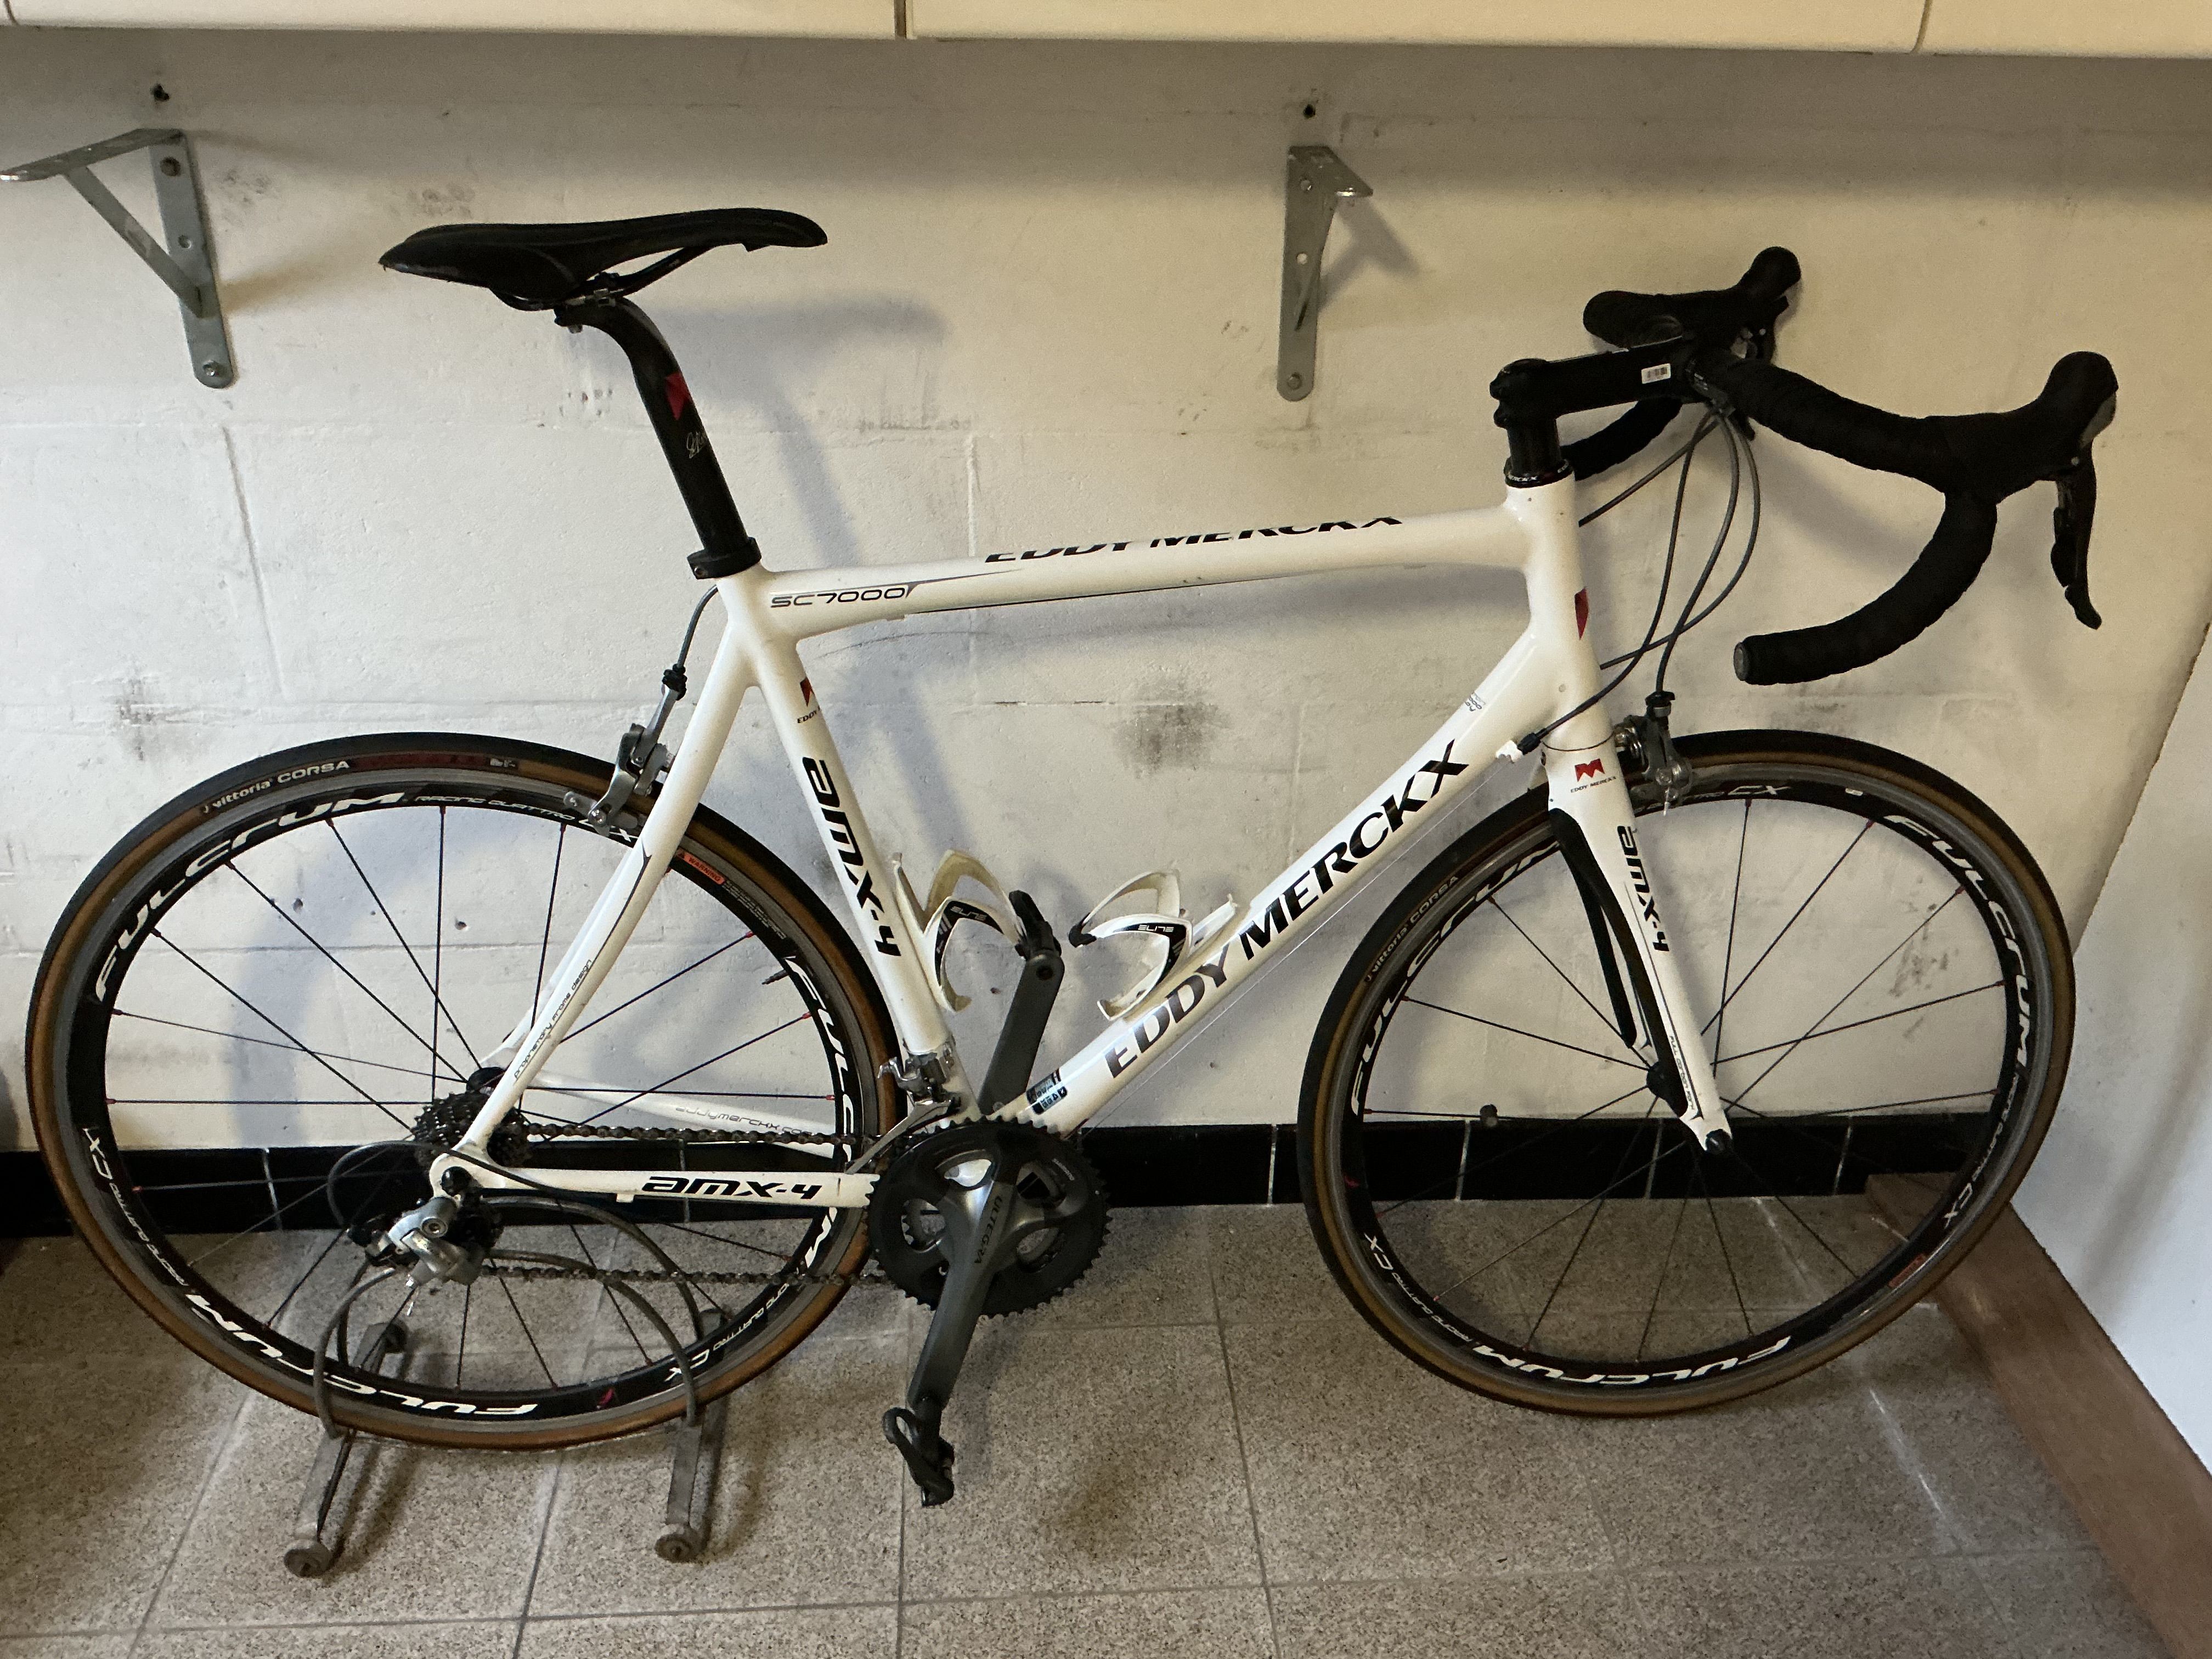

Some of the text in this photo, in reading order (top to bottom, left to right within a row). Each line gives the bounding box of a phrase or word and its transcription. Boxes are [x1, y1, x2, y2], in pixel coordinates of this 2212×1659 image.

[770, 588, 905, 608] SC7000
[213, 760, 350, 808] vittoria CORSA
[1728, 785, 1791, 795] CX
[688, 856, 721, 882] WARNING
[1102, 738, 1469, 1079] EDDY MERCKX
[1372, 876, 1459, 972] vittoria CORSA
[514, 1022, 553, 1080] proprietary
[571, 959, 592, 991] design
[974, 1195, 1003, 1264] ULTEGRA
[1364, 1233, 1394, 1270] CX
[1472, 1335, 1792, 1385] FULCRUM
